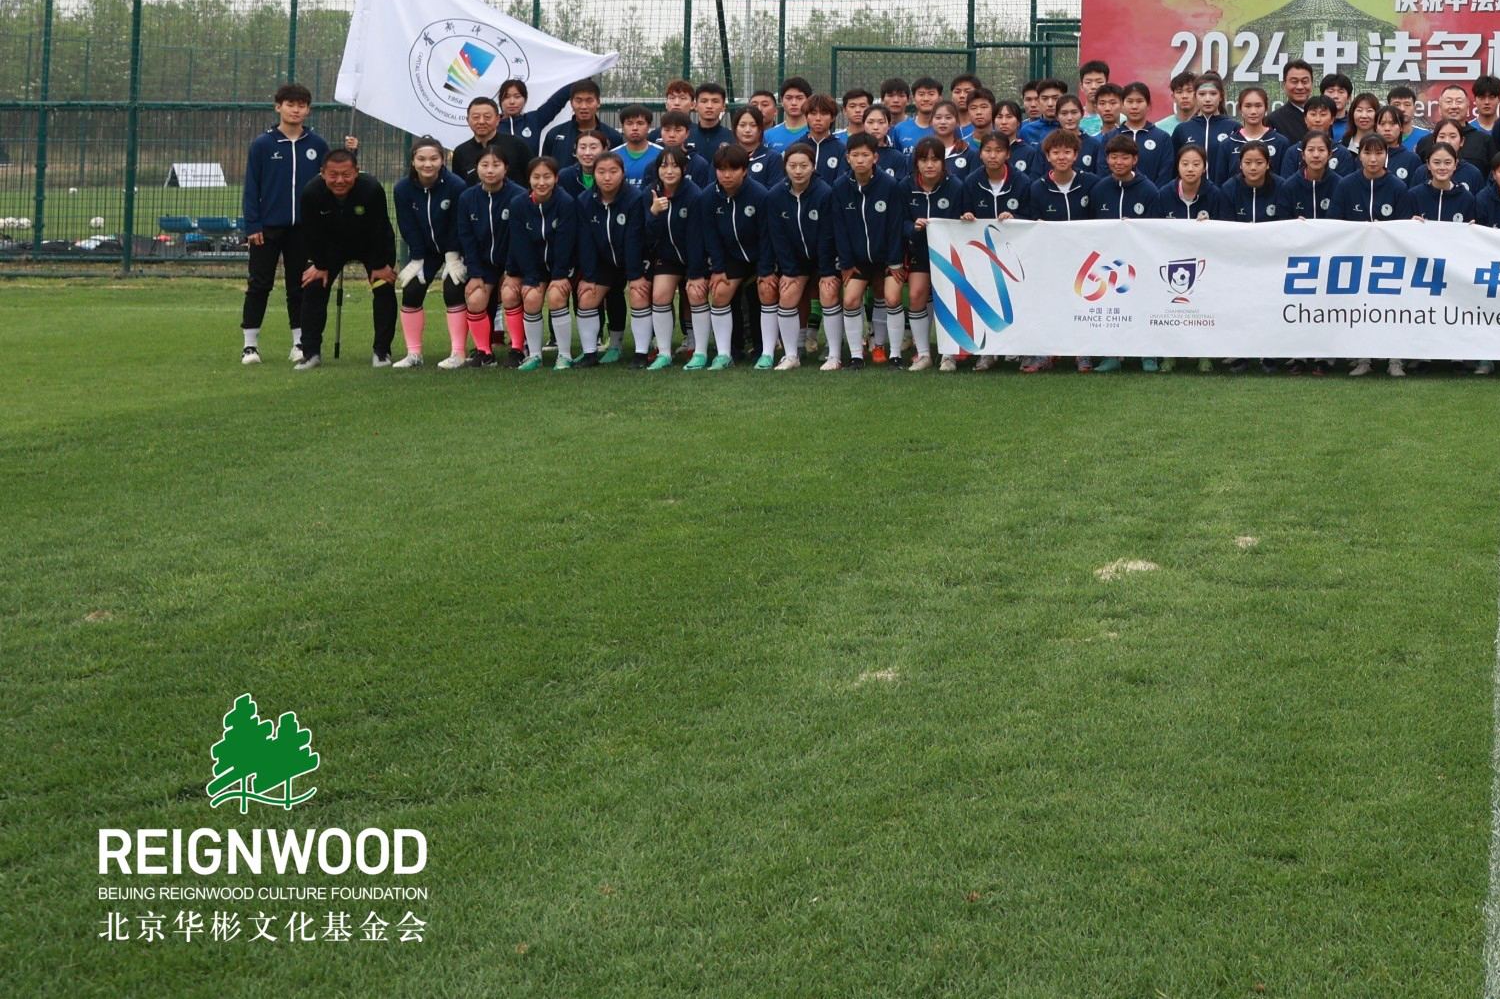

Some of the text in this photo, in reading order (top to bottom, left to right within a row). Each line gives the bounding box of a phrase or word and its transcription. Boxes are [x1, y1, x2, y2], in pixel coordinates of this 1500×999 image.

[447, 94, 464, 105] 1956
[1283, 255, 1448, 296] 2024
[1105, 315, 1133, 323] CHINE
[1282, 303, 1437, 329] Championnat
[1149, 319, 1216, 327] FRANCO-CHINOIS
